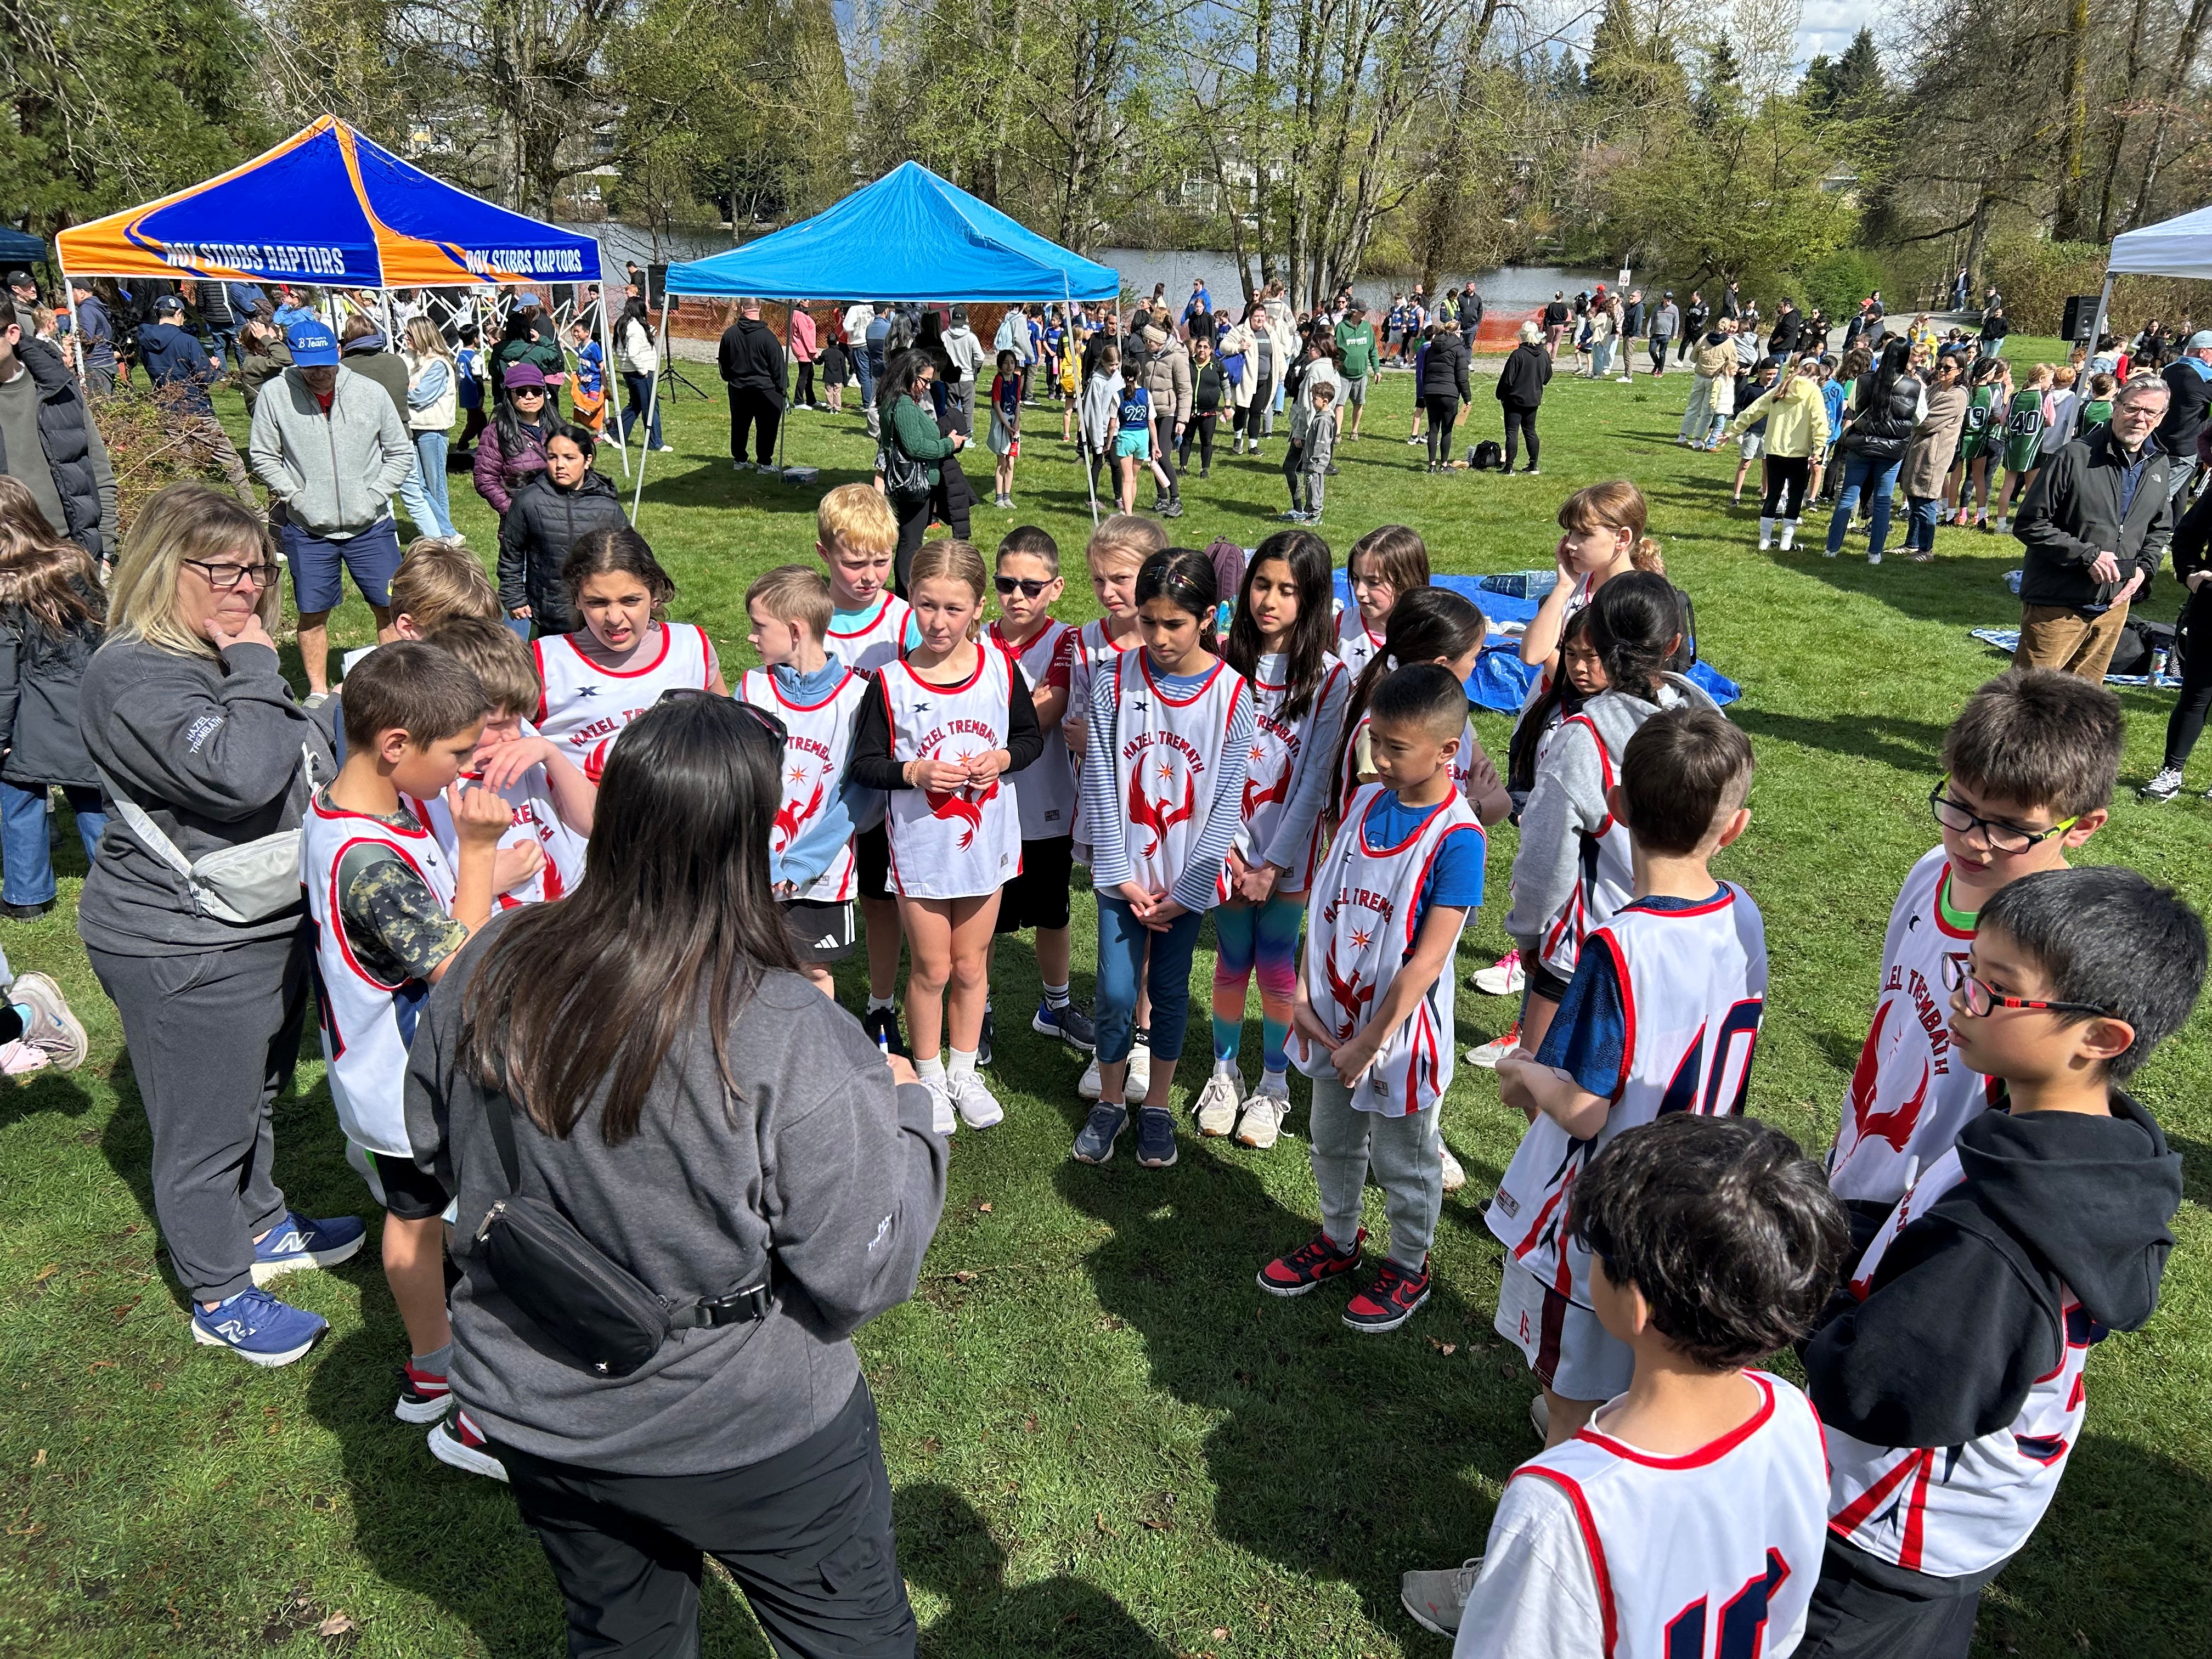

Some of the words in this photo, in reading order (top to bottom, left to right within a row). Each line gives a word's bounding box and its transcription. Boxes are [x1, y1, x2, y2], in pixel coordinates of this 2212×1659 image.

[162, 242, 196, 267] ROY
[199, 244, 264, 270] STIBBS
[263, 245, 345, 274] RAPTORS
[466, 250, 489, 274] ROY
[492, 250, 533, 273] STIBBS
[534, 249, 583, 273] RAPTORS
[298, 337, 305, 348] B
[306, 337, 329, 348] Team
[2010, 410, 2039, 435] 40
[187, 716, 211, 741] HAZEL
[190, 716, 223, 753] TREMBATH
[569, 717, 620, 747] HAZEL
[916, 727, 946, 758] HAZEL
[947, 719, 998, 751] TREMBATH
[1123, 732, 1154, 760] HAZEL
[1520, 1310, 1530, 1344] 15
